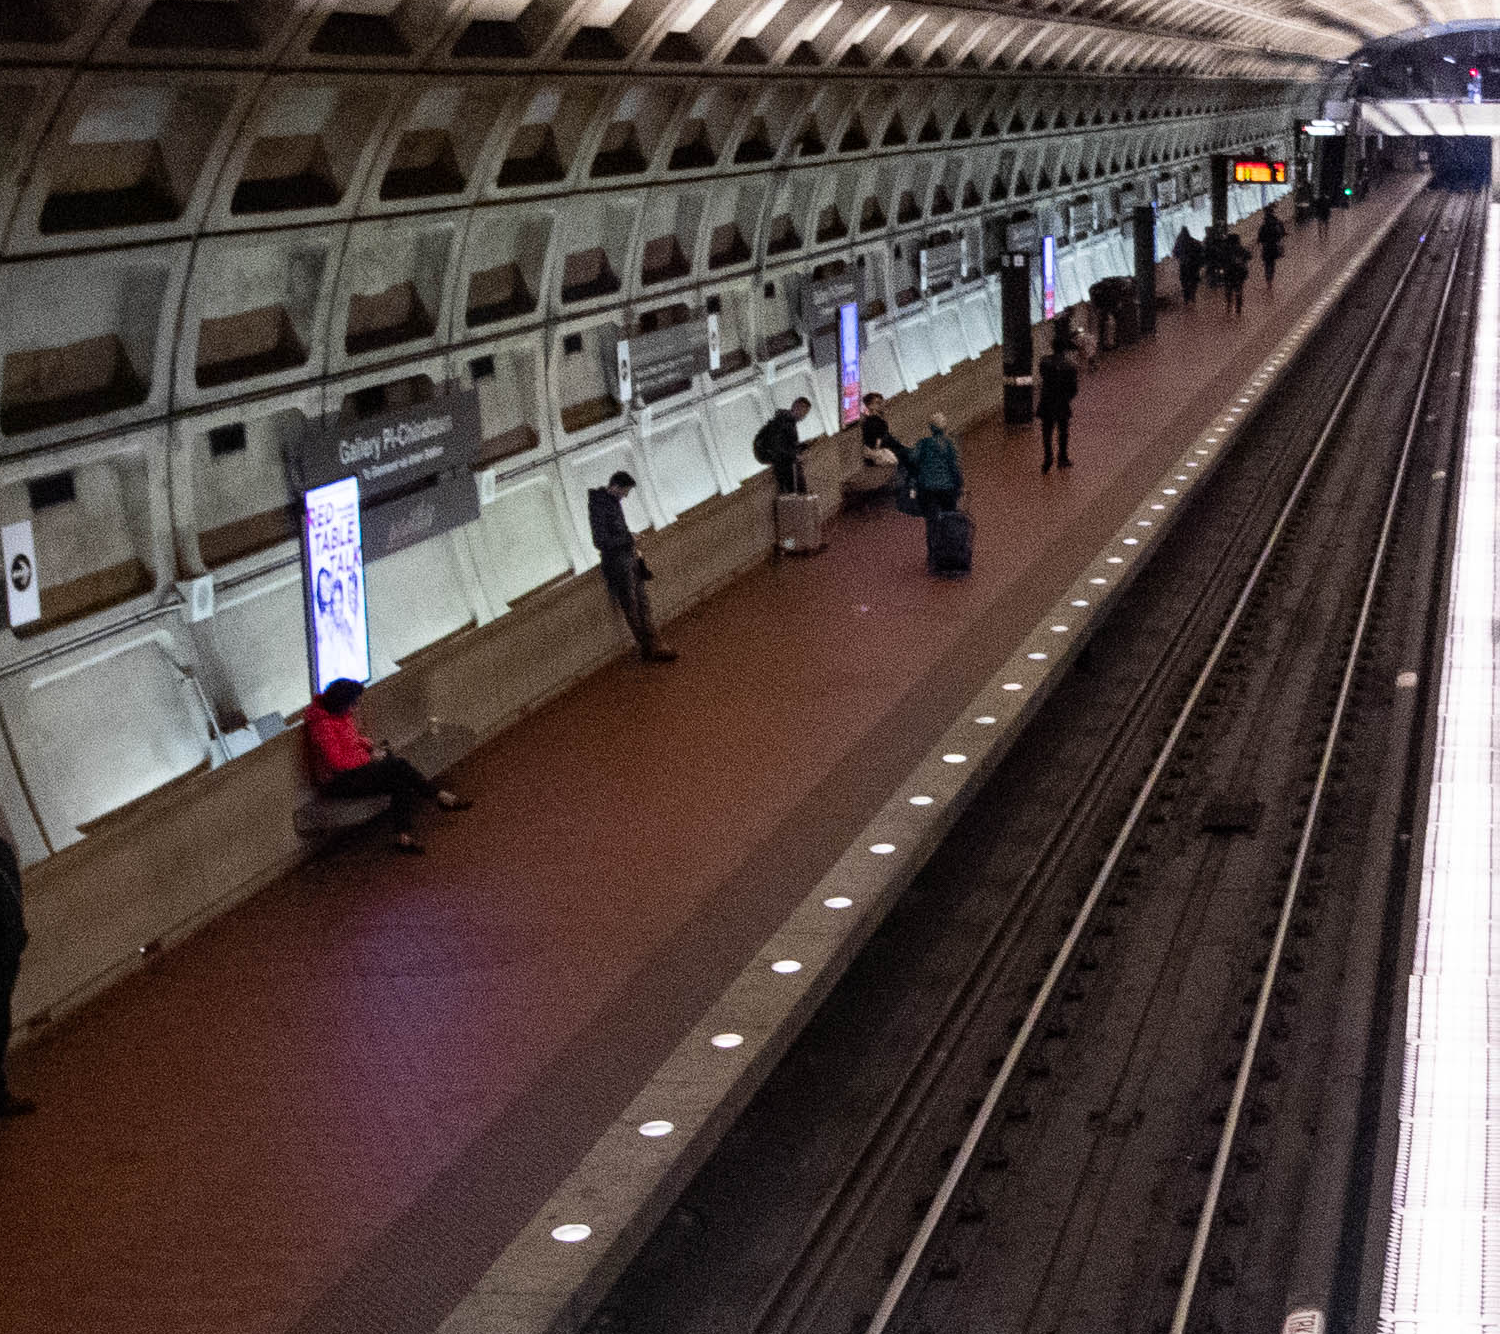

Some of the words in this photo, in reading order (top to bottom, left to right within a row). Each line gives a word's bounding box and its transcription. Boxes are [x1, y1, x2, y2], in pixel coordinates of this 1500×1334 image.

[339, 436, 381, 465] Gallery
[313, 520, 354, 557] TABLE
[329, 546, 362, 577] TALK
